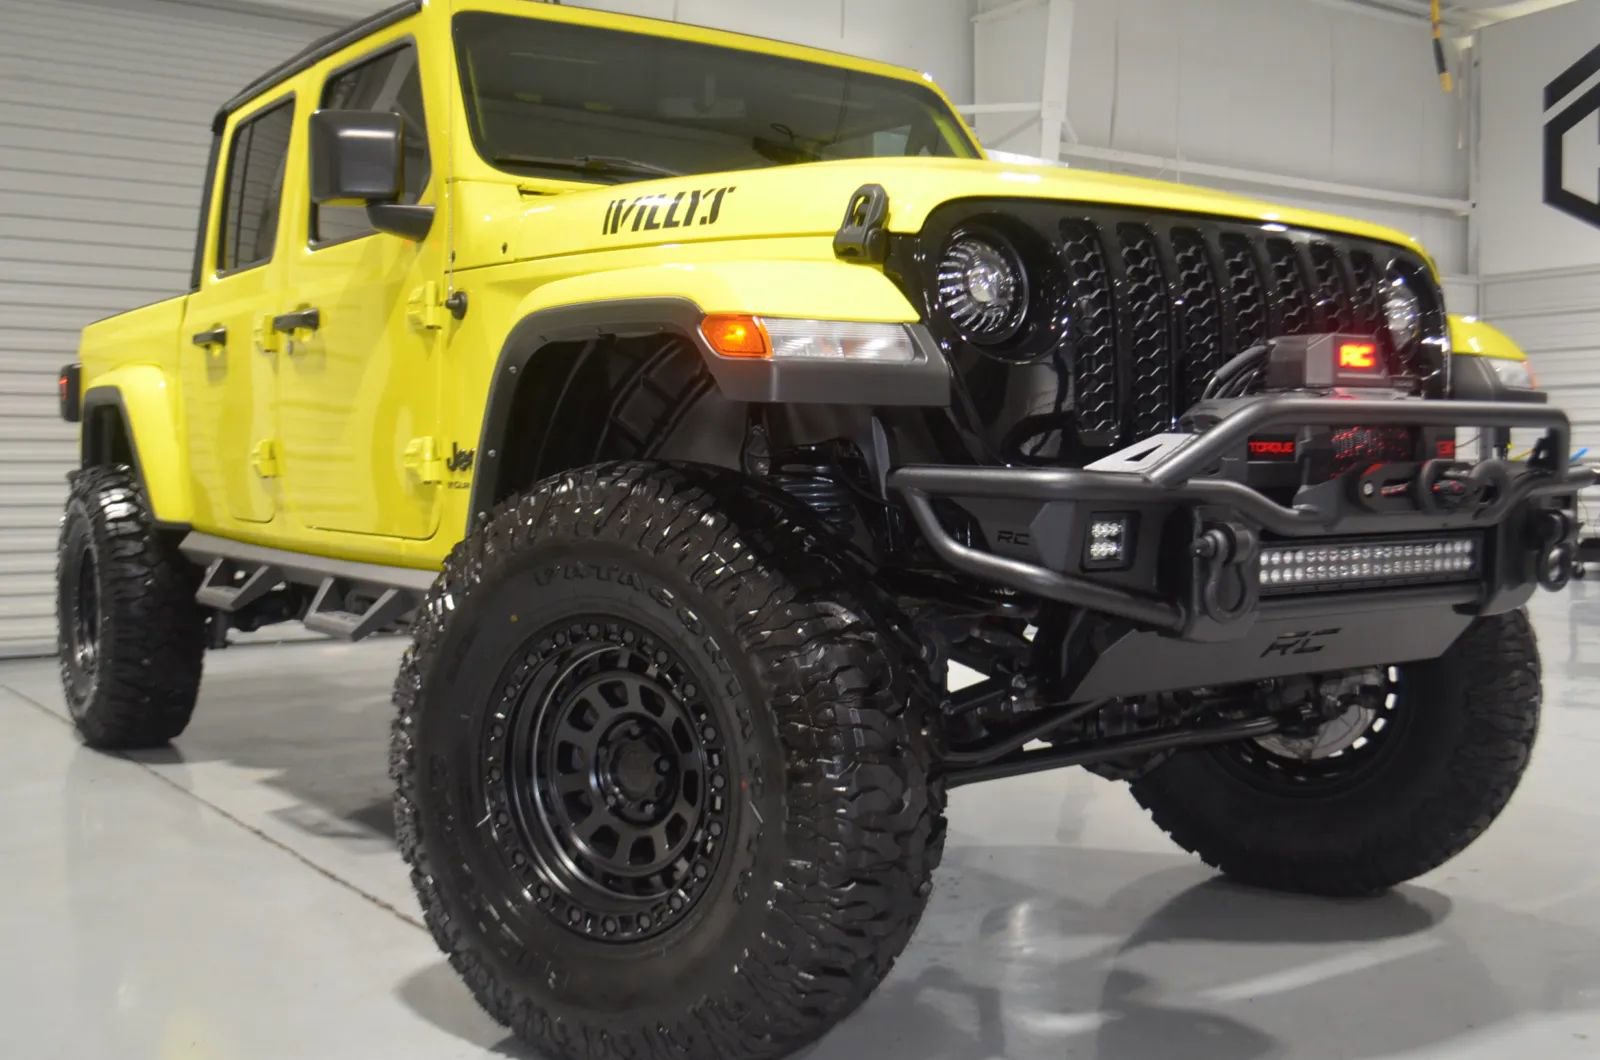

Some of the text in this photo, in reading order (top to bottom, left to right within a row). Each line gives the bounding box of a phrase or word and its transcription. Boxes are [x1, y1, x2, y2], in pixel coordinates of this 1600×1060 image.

[602, 187, 735, 235] WILLYS
[1339, 344, 1375, 368] RC
[1248, 441, 1294, 454] TORQUE
[998, 530, 1030, 546] RC
[1260, 628, 1342, 657] RC
